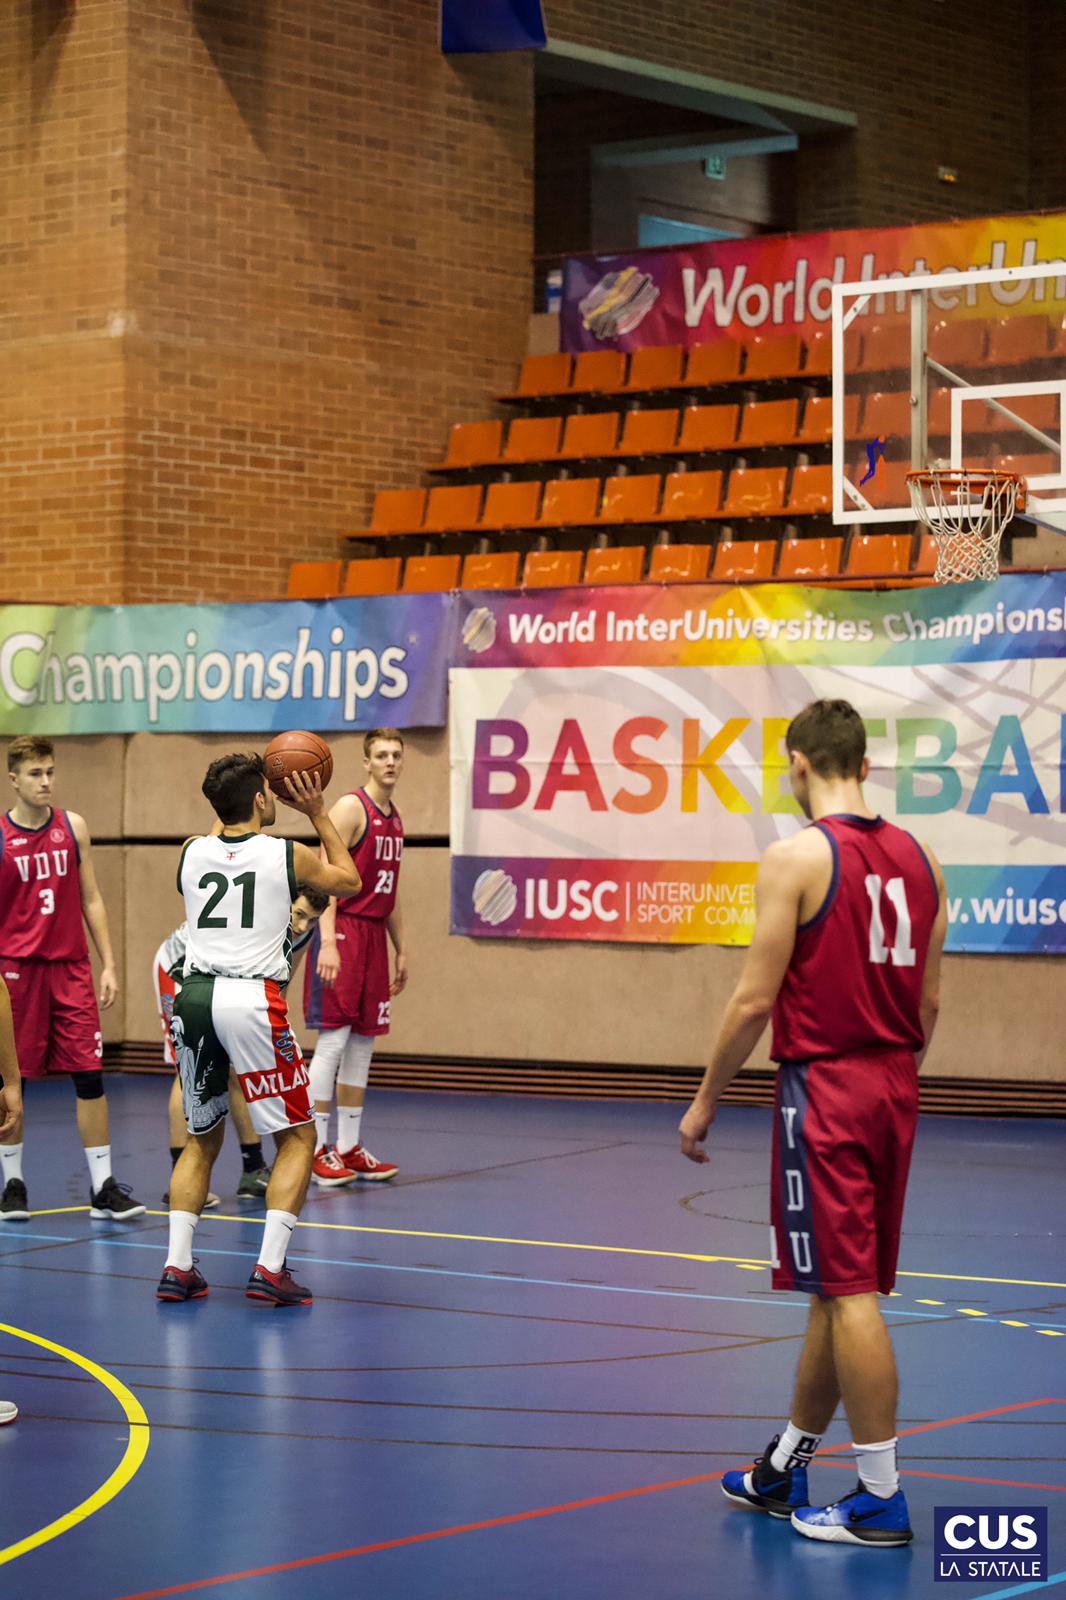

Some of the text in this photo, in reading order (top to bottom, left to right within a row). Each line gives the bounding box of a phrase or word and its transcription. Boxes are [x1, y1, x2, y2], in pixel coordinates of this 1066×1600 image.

[681, 256, 846, 328] World
[508, 596, 1066, 645] World InterUniversities Champions
[1, 626, 410, 724] Championships
[471, 715, 1066, 815] BASKEBA
[14, 849, 68, 882] VDU
[375, 835, 403, 861] VDU
[39, 888, 55, 915] 3
[197, 871, 256, 929] 21
[374, 869, 394, 894] 23
[525, 878, 619, 922] IUSC
[636, 880, 757, 905] INTERUNIVE
[637, 904, 695, 925] SPORT
[865, 873, 916, 966] 11
